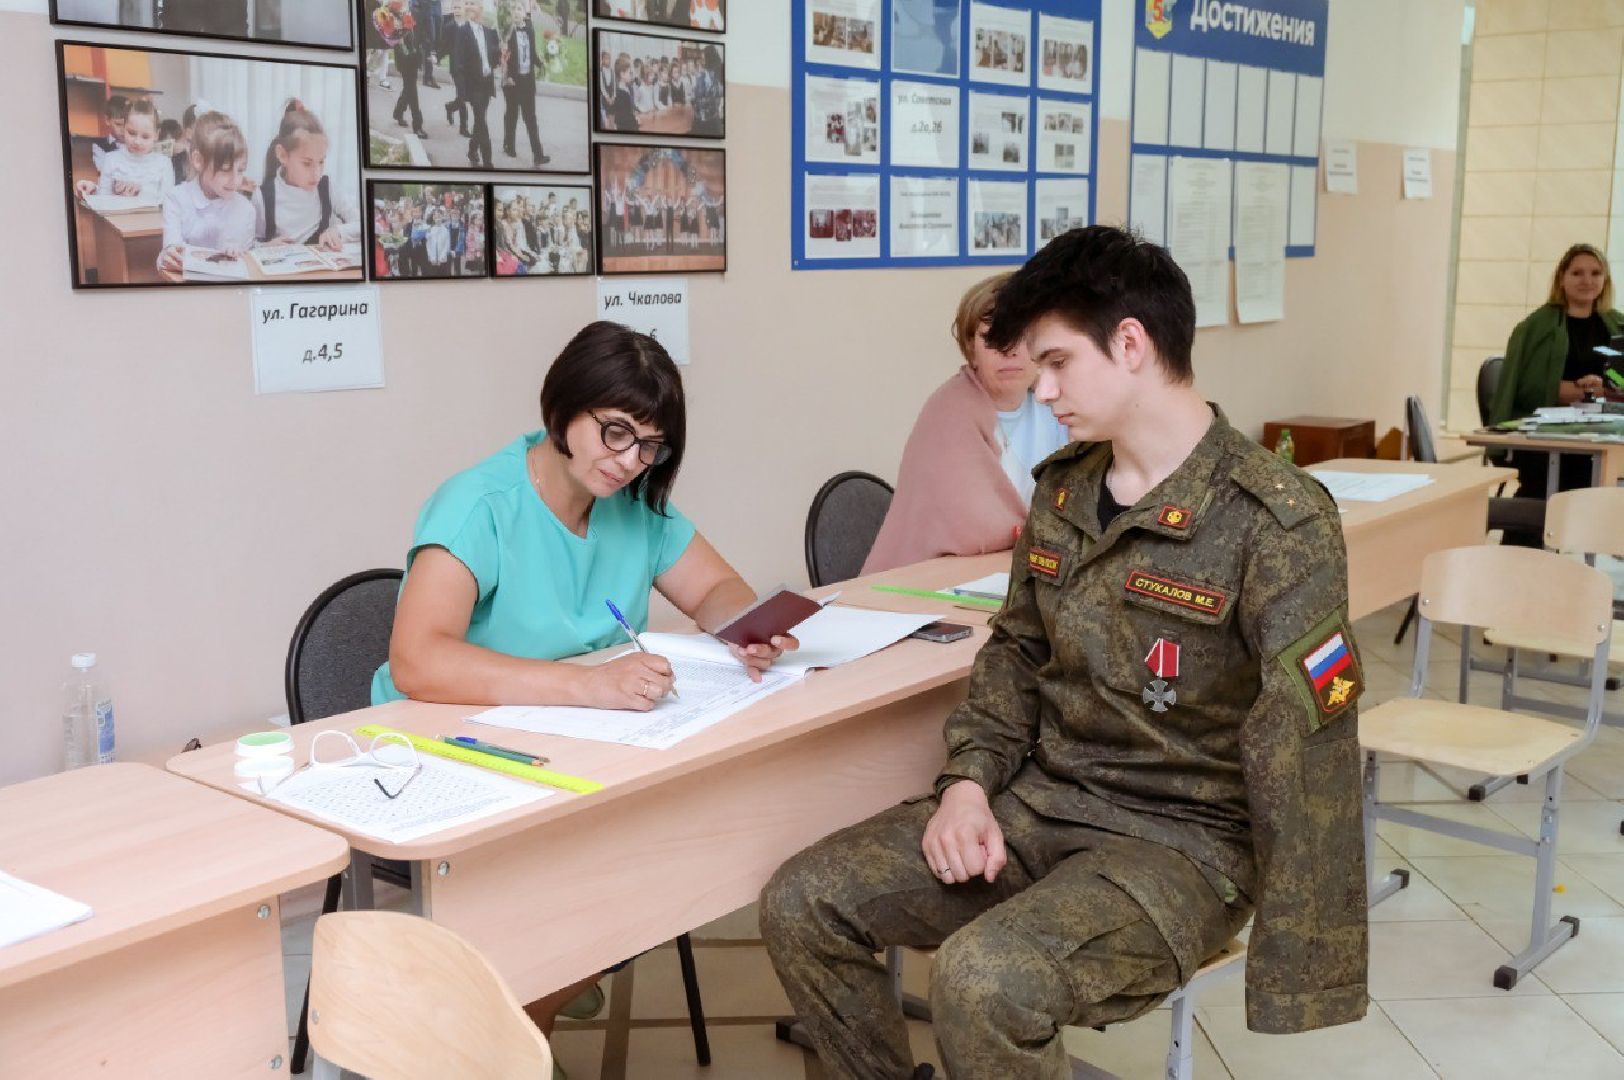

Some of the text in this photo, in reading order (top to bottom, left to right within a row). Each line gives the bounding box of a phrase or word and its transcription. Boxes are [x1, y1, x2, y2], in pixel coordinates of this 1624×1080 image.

[1190, 0, 1316, 46] Достижения
[604, 291, 682, 311] ул. Чкалова
[262, 302, 369, 324] ул. Гагарина
[302, 342, 343, 364] д.4,5
[1135, 577, 1193, 601] СТУКАЛОВ
